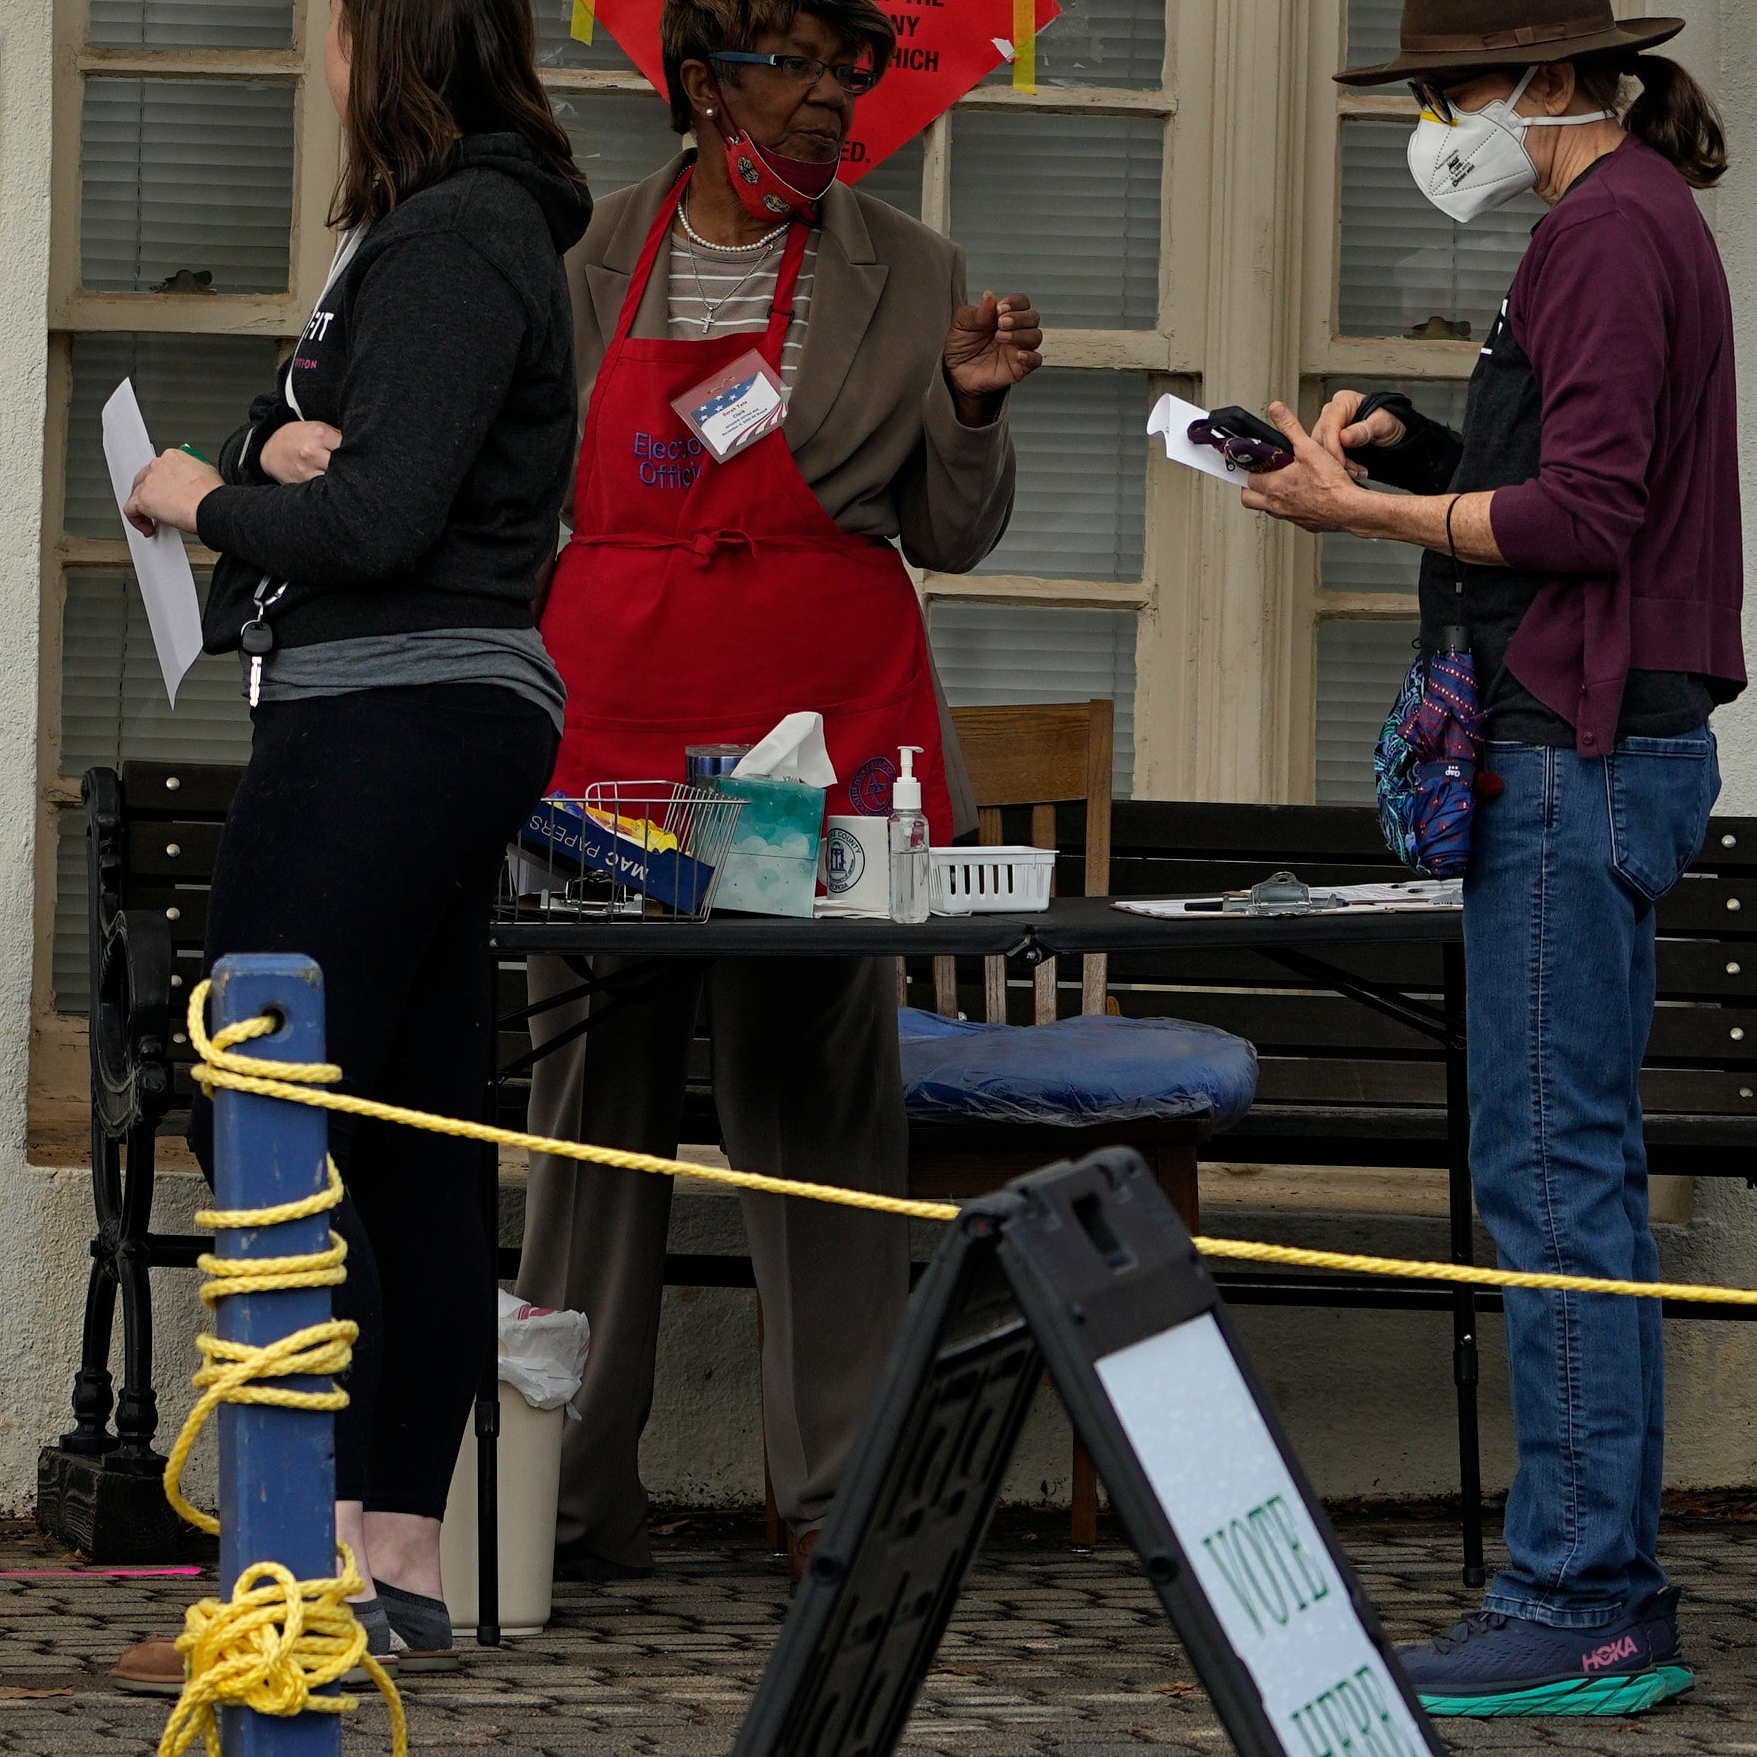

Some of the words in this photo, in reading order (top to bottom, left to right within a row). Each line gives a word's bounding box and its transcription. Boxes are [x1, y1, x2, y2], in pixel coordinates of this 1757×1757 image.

[890, 14, 921, 37] NY
[889, 47, 940, 73] HICH
[529, 814, 602, 859] PAPERS
[604, 850, 650, 881] MAC
[1201, 1493, 1329, 1640] VOTE
[1581, 1635, 1639, 1673] HOKA
